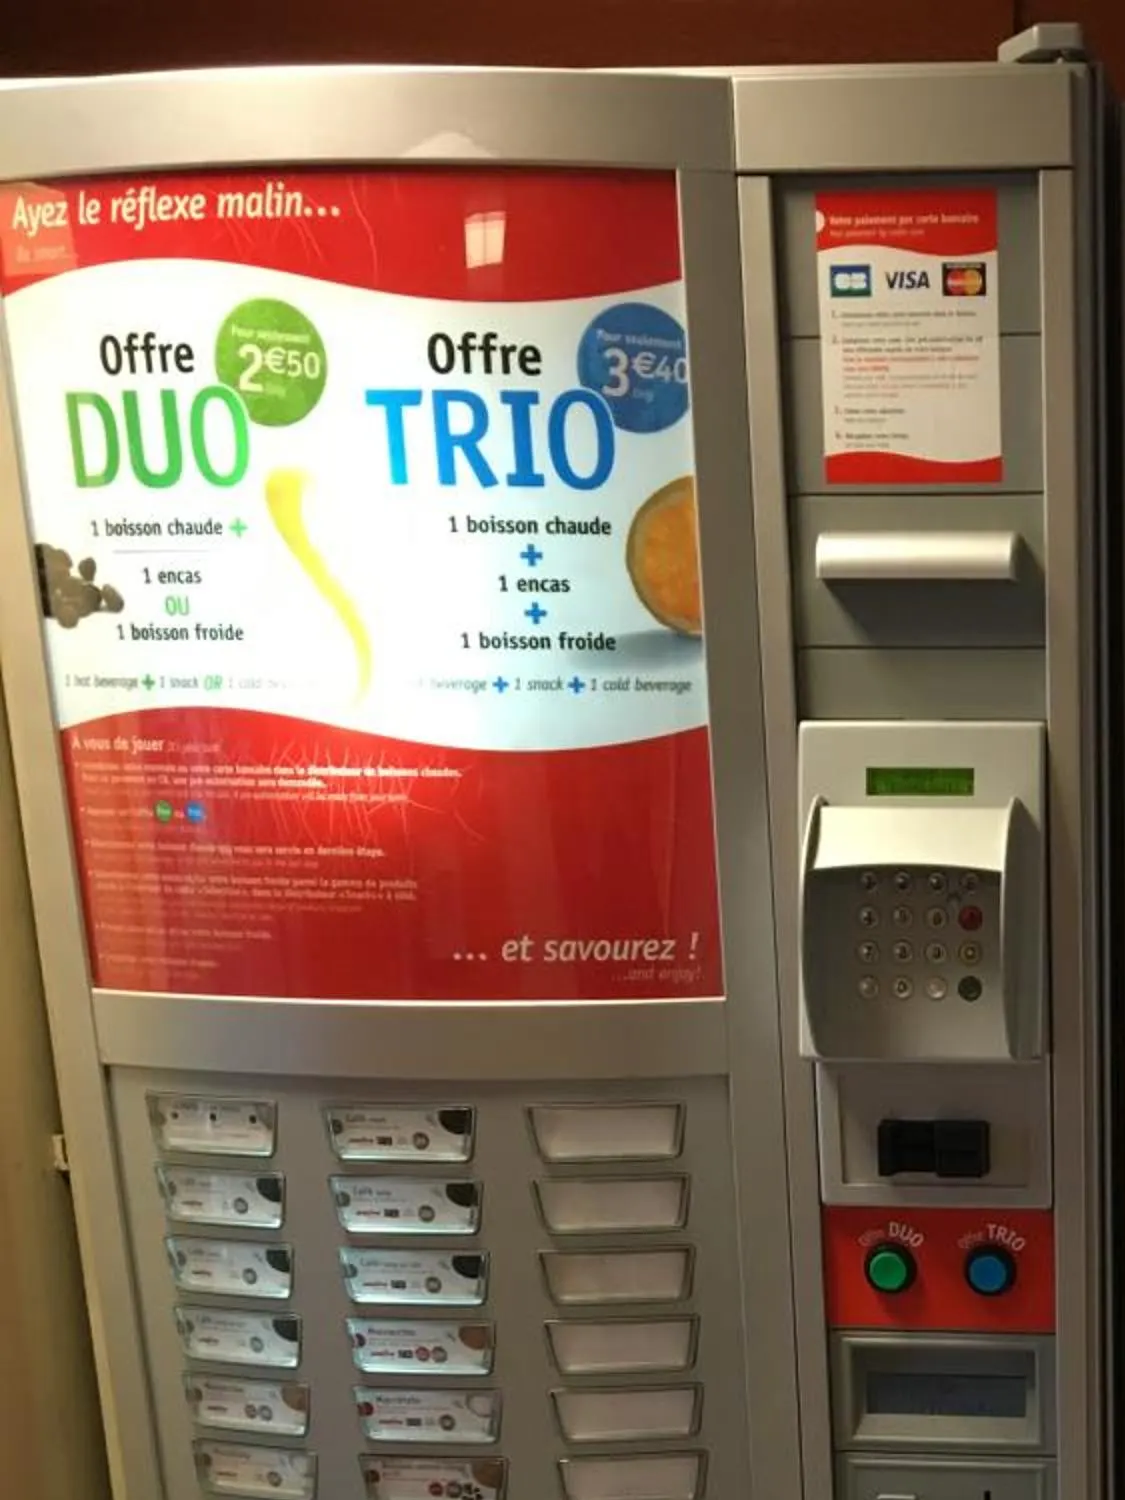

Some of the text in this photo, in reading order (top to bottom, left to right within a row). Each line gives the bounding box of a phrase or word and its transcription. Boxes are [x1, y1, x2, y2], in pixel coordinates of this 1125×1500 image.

[12, 182, 341, 237] Ayez le réflexe malin...
[885, 270, 931, 289] VISA
[100, 332, 195, 376] Offre
[428, 331, 542, 376] Offre
[64, 386, 250, 490] DUO
[364, 388, 615, 491] TRIO
[91, 518, 223, 537] 1 boisson chaude
[449, 515, 612, 536] 1 boisson chaude
[143, 568, 203, 584] 1 encas
[499, 575, 571, 593] 1 encas
[165, 596, 190, 616] OU
[117, 623, 245, 641] 1 boisson froide
[461, 631, 617, 651] 1 boisson froide
[527, 676, 564, 691] snack
[602, 676, 630, 692] cold
[635, 677, 692, 695] beverage
[502, 934, 533, 962] et
[543, 937, 675, 962] savourez
[888, 1221, 924, 1247] DUO
[986, 1224, 1026, 1251] TRIO
